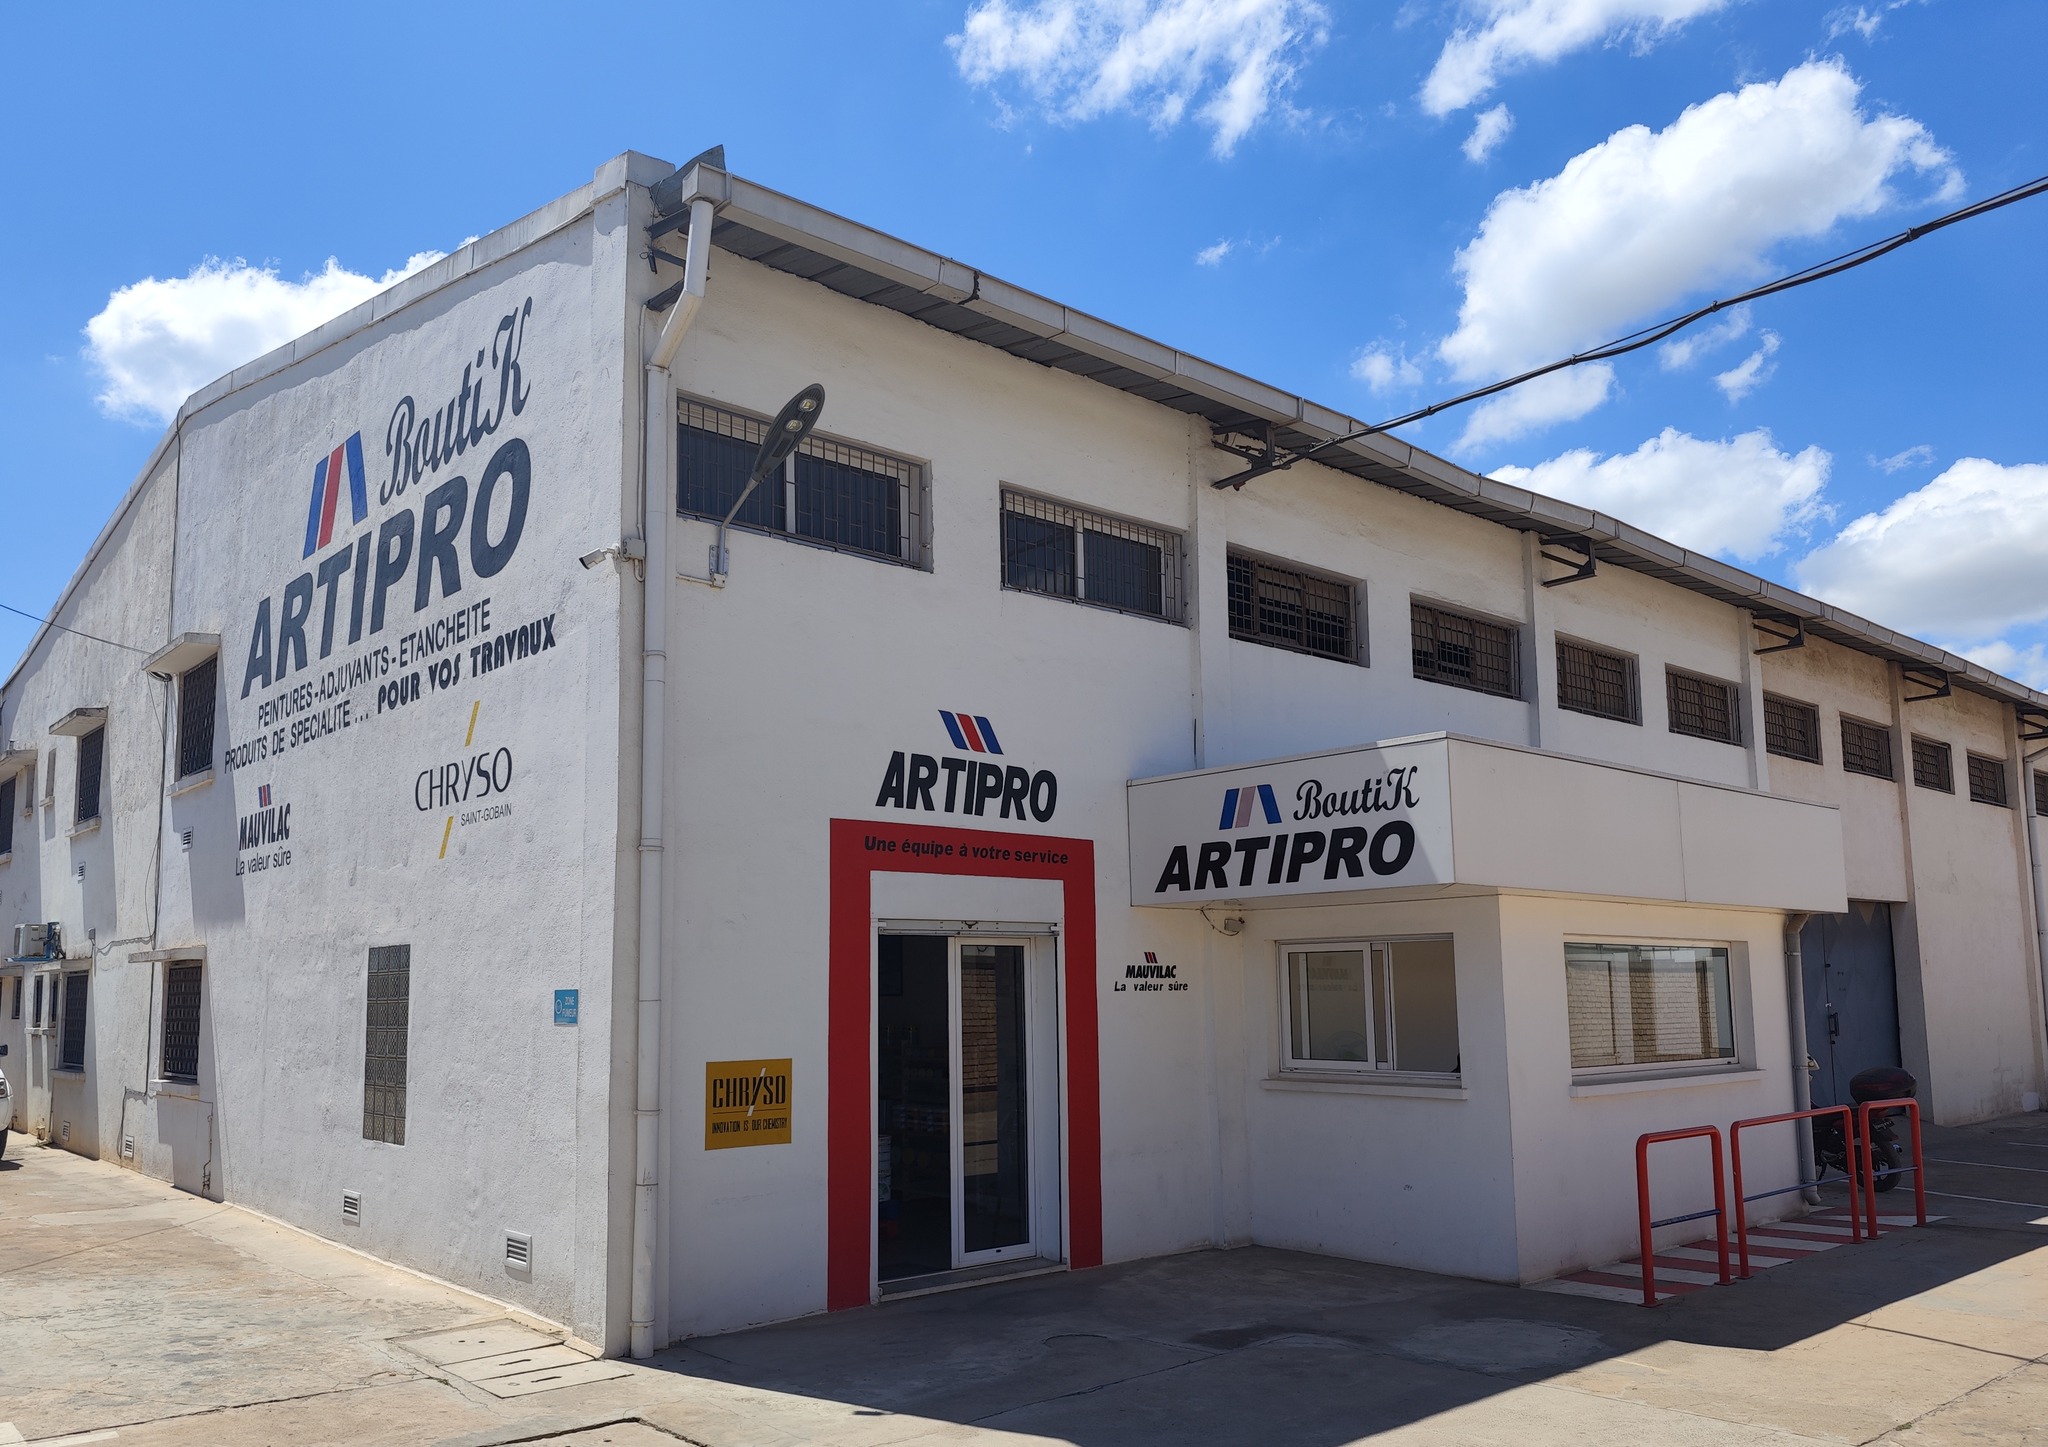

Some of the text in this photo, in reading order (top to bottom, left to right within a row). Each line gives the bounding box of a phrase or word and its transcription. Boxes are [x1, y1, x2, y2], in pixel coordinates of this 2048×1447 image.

[379, 296, 533, 506] BoutiK
[240, 437, 532, 701] ARTIPRO
[224, 734, 268, 775] PRODUITS
[272, 726, 285, 756] DE
[377, 671, 421, 715] POUR
[428, 652, 461, 695] VOS
[470, 612, 557, 679] TRAVAUX
[414, 746, 513, 812] CHRYSO
[875, 751, 1057, 822] ARTIPRO
[1293, 765, 1421, 821] BoutiK
[238, 802, 291, 852] MAUVILAC
[460, 802, 512, 827] SAINT-GOBAIN
[235, 845, 292, 877] La valeur sûre
[864, 835, 1069, 864] Une équipe à votre service
[1154, 820, 1416, 893] ARTIPRO
[1114, 980, 1188, 992] La valeur sûre
[1125, 964, 1177, 979] MAUVILAC
[713, 1075, 786, 1108] CHRYSO
[712, 1122, 740, 1134] INNOVATION
[744, 1120, 749, 1131] IS
[752, 1120, 761, 1131] OUR
